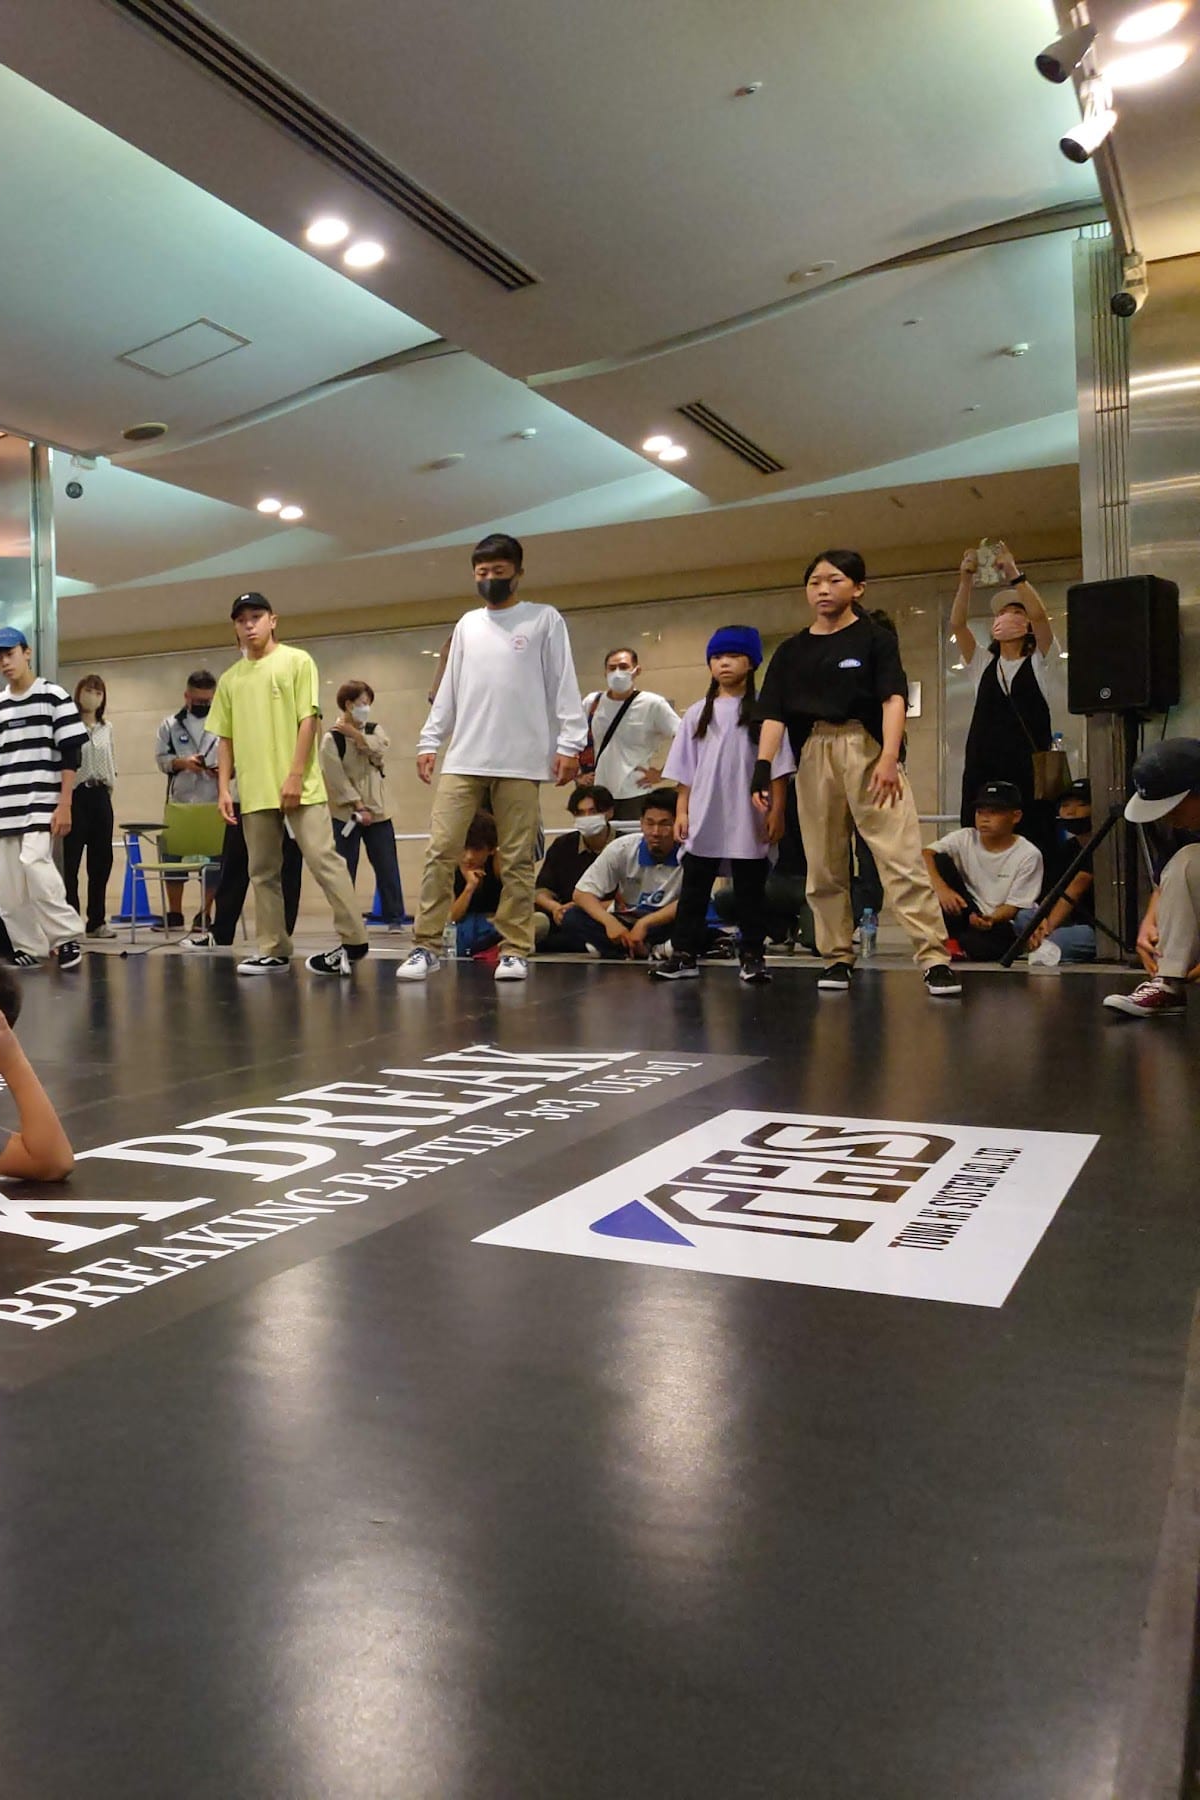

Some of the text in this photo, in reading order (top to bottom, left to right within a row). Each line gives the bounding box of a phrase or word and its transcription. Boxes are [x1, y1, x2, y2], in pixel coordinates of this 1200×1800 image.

[73, 1044, 640, 1183] BREAK
[321, 1124, 535, 1190] BATTLE
[888, 1222, 963, 1251] TOWA
[928, 1174, 1001, 1209] SYSTEM
